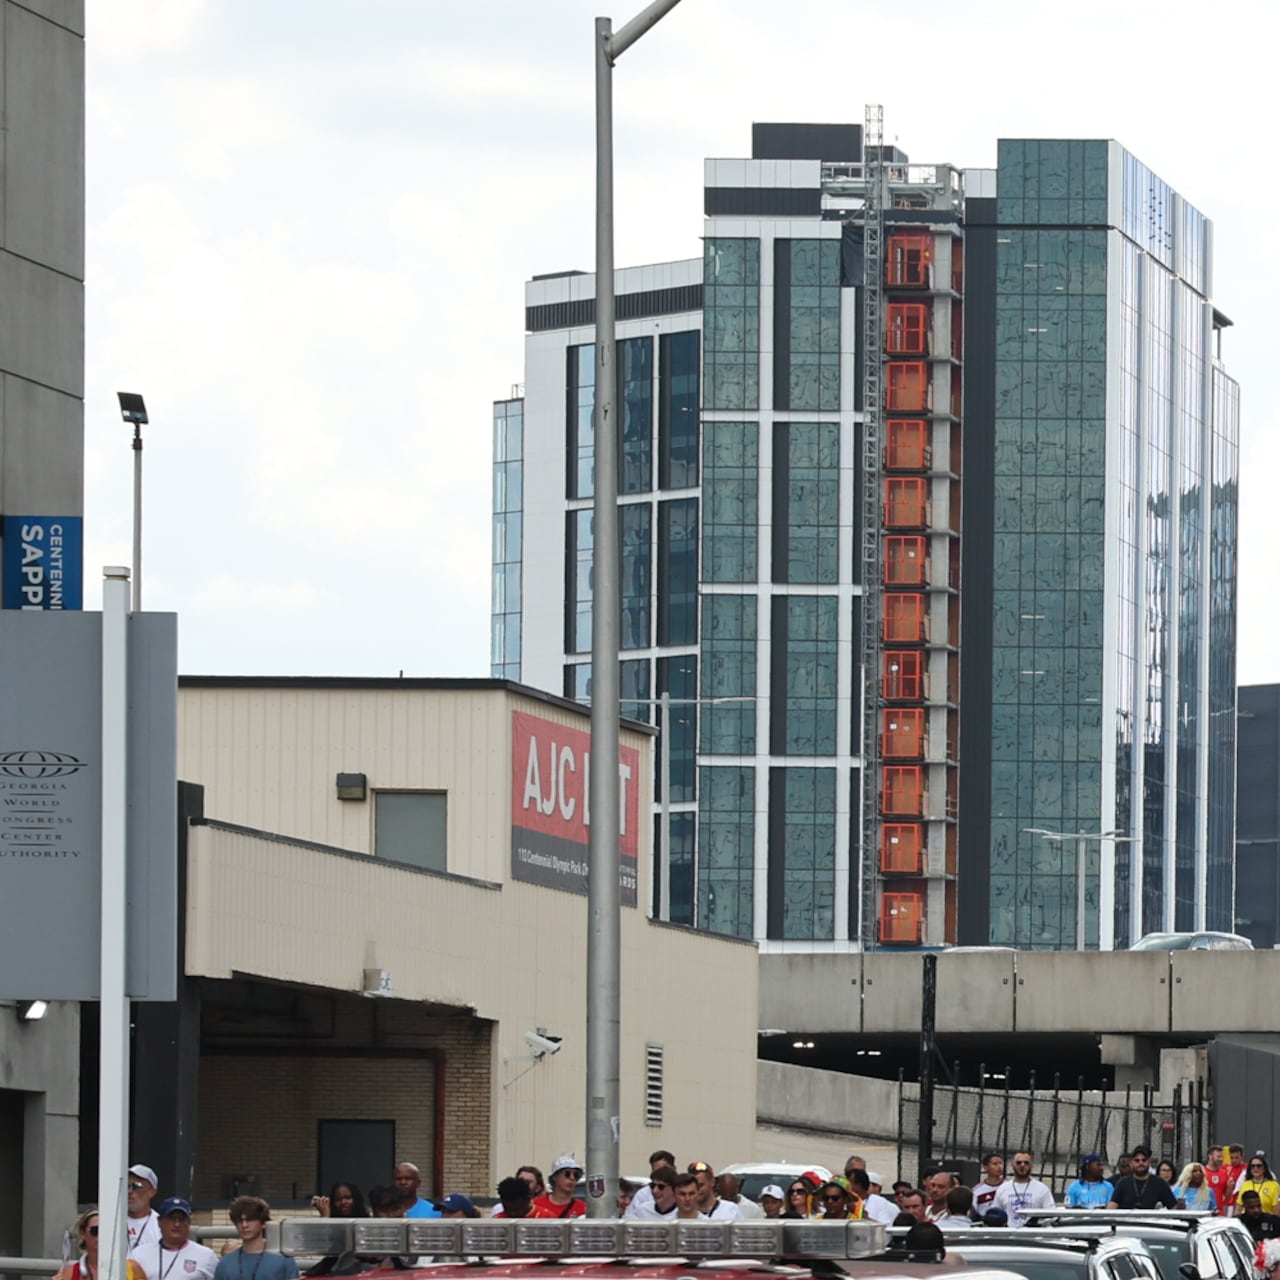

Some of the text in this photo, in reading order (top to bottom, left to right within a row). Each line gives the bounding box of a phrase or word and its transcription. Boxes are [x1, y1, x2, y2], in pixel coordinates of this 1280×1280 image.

[522, 734, 577, 822] AJC
[527, 850, 553, 869] Centennial
[553, 855, 571, 874] Olympic
[571, 860, 581, 875] Park
